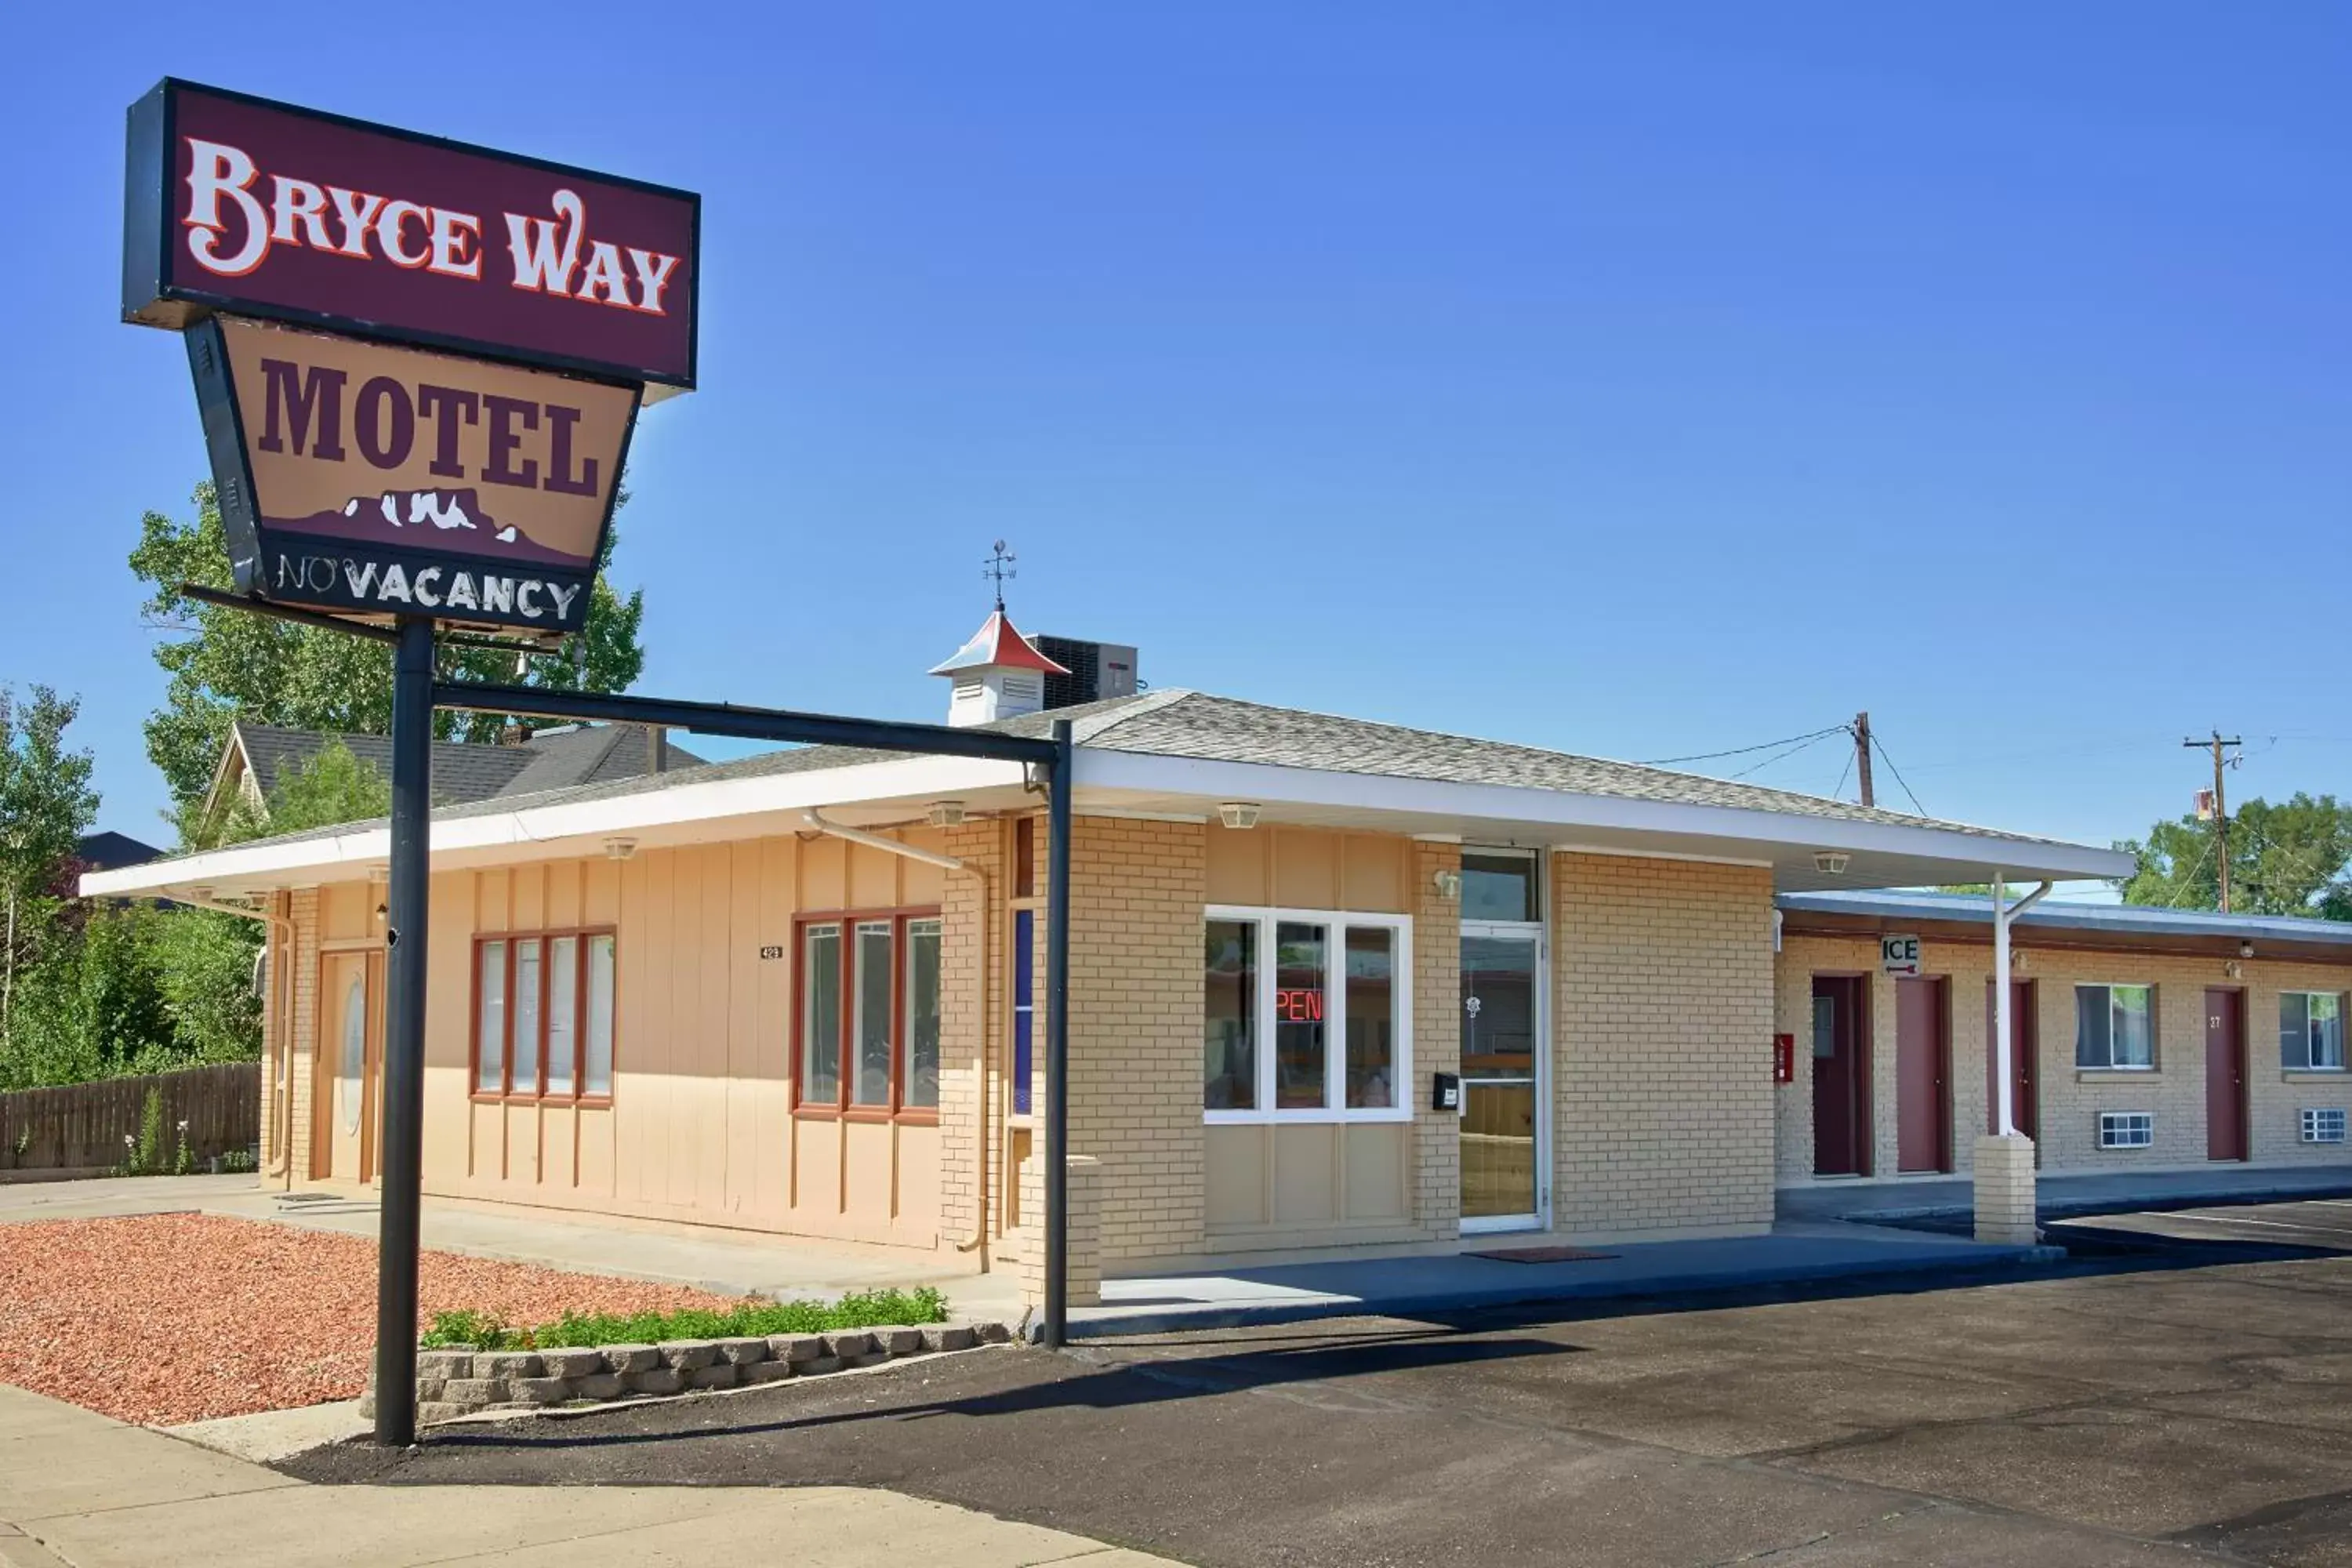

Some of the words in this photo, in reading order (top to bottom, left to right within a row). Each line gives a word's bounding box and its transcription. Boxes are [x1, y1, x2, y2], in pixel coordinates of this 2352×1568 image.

[182, 136, 484, 281] BRYCE
[503, 188, 683, 316] WAY
[258, 357, 598, 498] MOTEL
[277, 554, 337, 593] NO
[343, 558, 581, 620] VACANCY
[1883, 939, 1918, 960] ICE
[1276, 991, 1321, 1021] PEN
